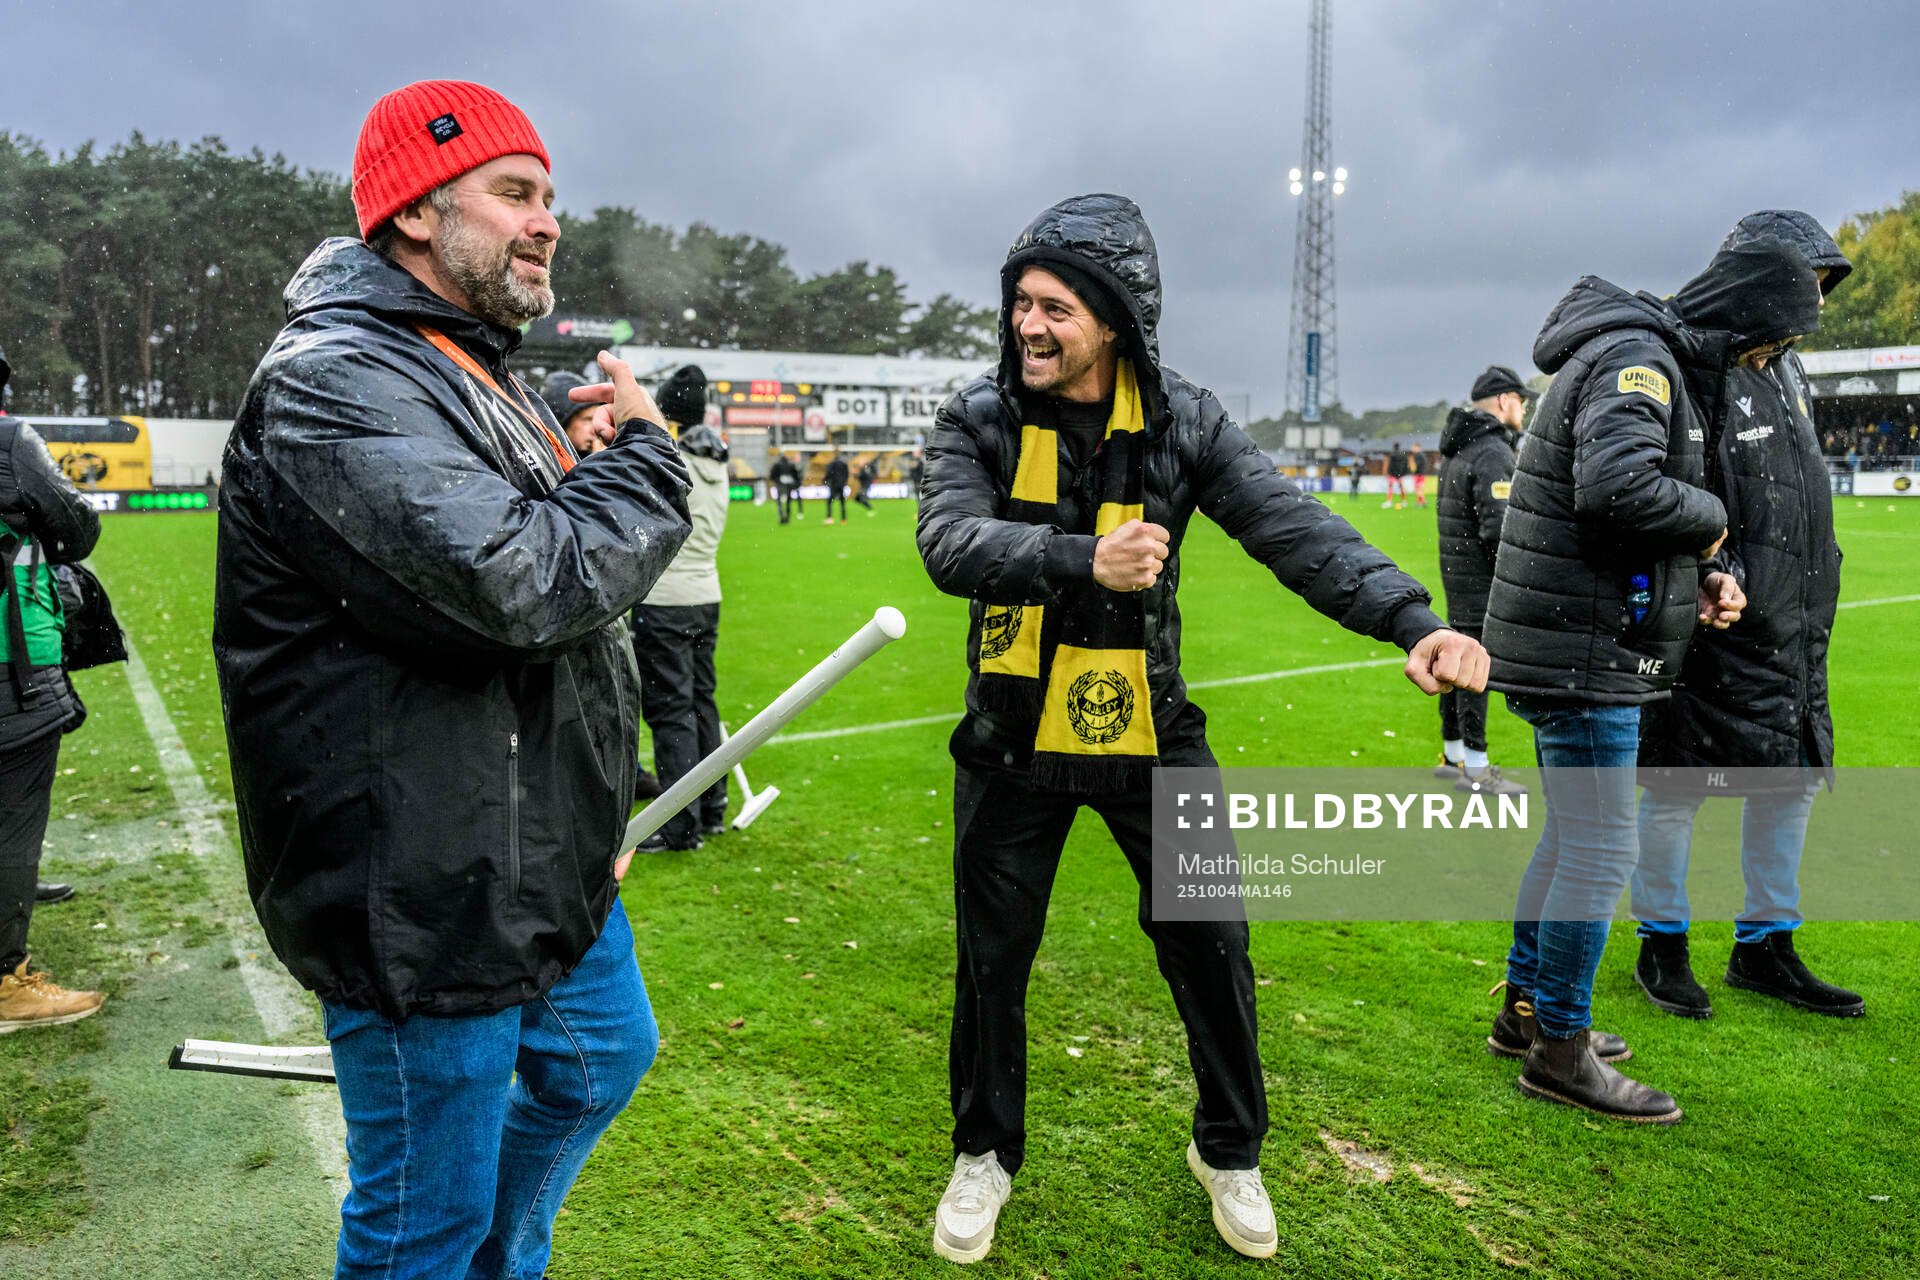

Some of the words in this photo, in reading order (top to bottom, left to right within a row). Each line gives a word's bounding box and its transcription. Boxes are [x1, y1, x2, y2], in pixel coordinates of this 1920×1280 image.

[1624, 372, 1667, 393] UNIBET
[837, 399, 878, 414] DOT
[1637, 658, 1665, 675] ME
[1706, 772, 1729, 788] HL
